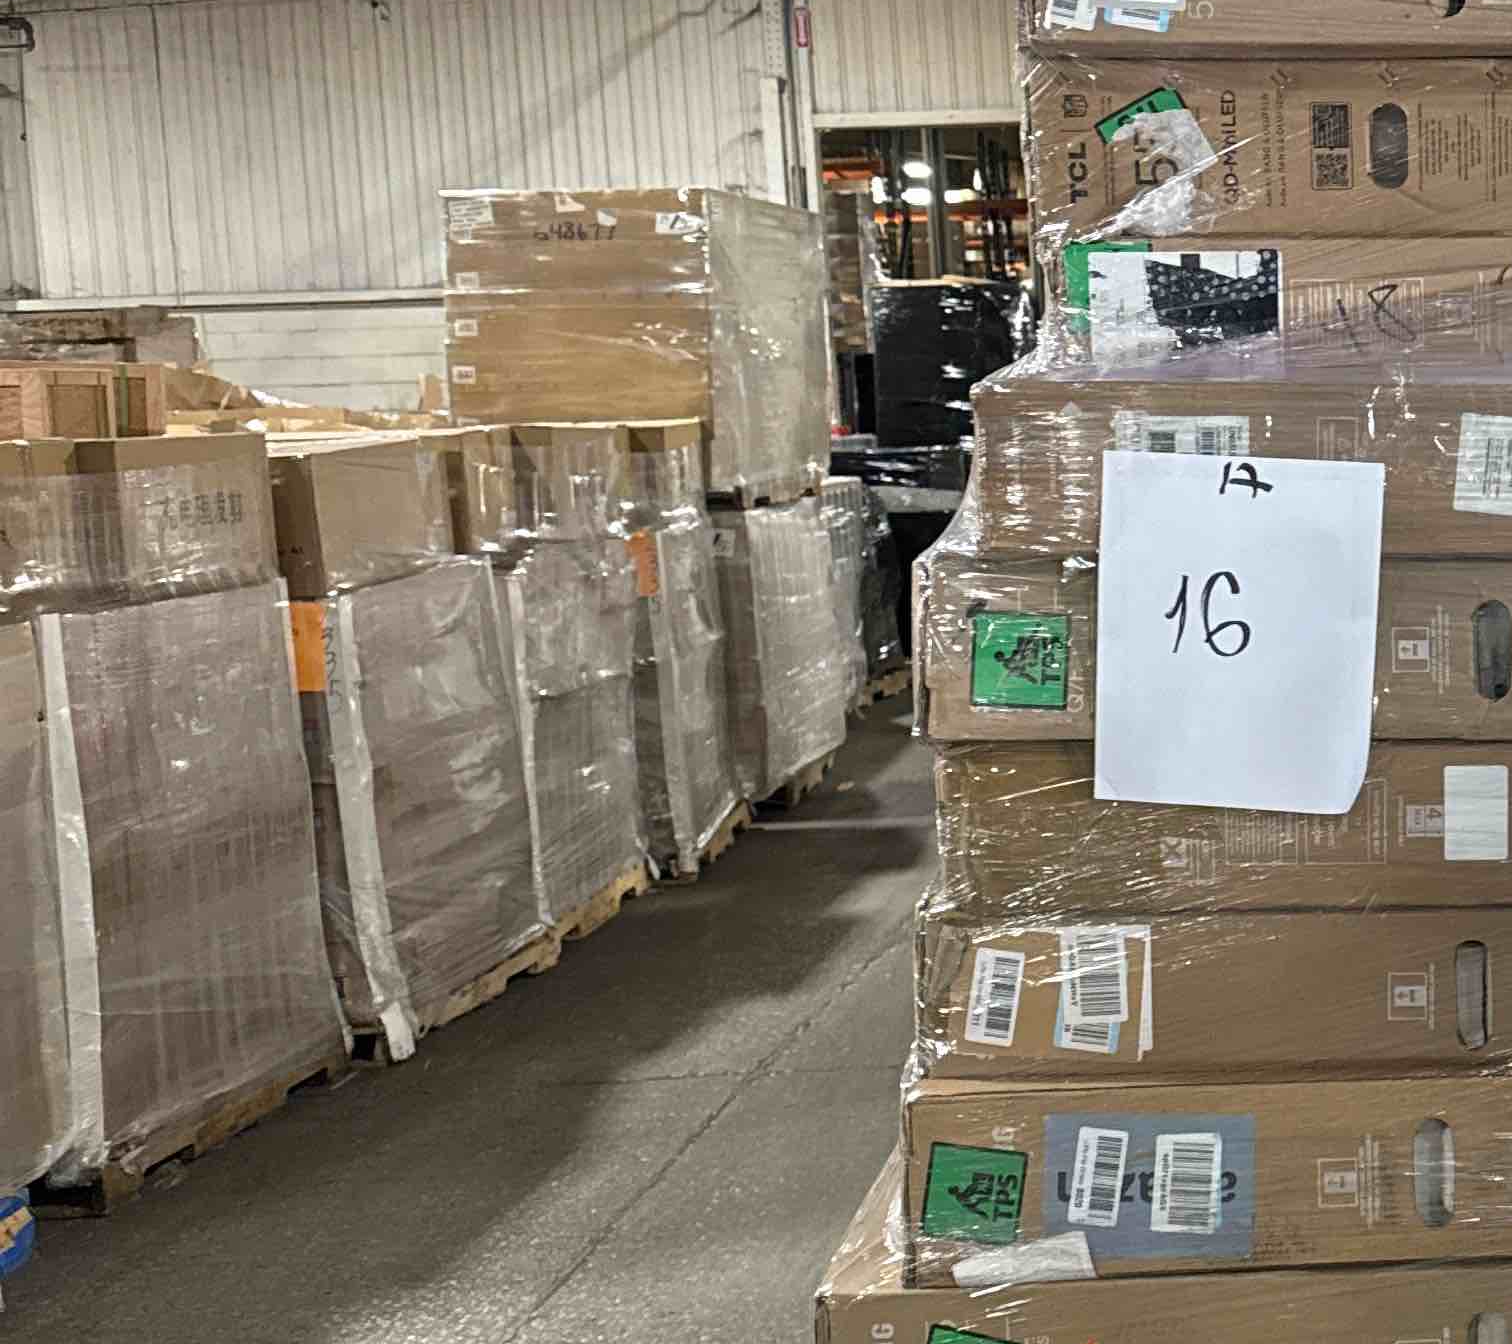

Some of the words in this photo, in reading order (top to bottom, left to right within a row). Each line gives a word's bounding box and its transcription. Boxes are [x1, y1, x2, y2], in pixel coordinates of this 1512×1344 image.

[1067, 142, 1089, 204] TCL
[1163, 570, 1252, 656] 16
[992, 1172, 1019, 1223] TPS
